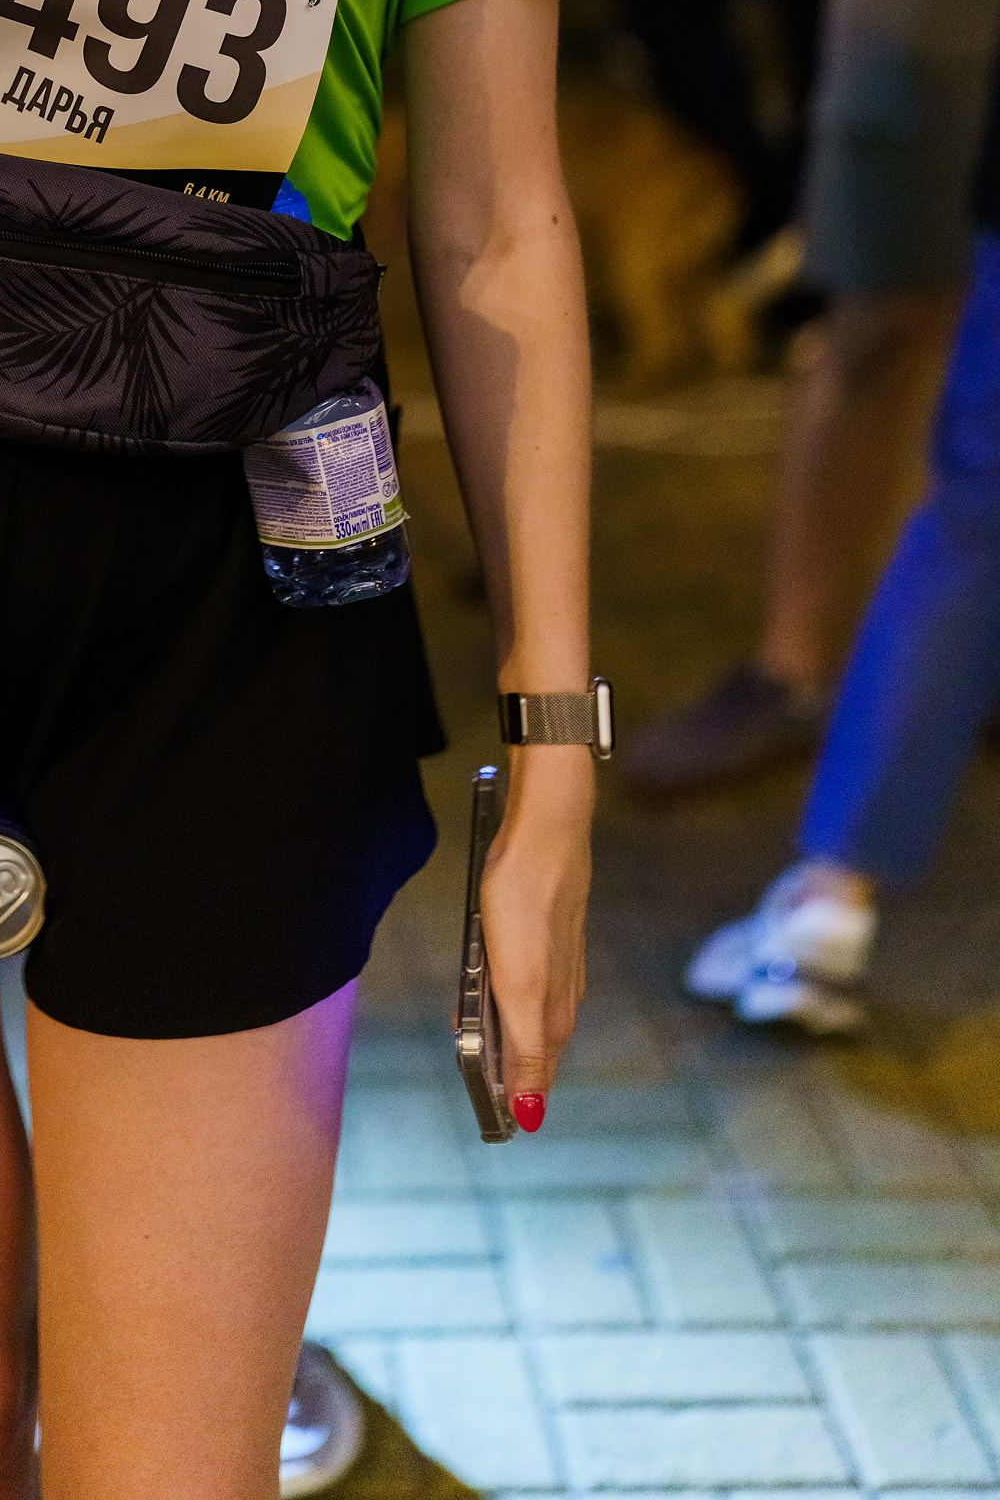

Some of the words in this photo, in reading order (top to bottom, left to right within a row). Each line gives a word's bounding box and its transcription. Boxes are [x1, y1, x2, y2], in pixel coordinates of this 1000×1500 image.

[1, 66, 116, 144] ДАРЬЯ
[183, 182, 207, 199] 64
[334, 520, 352, 539] 330
